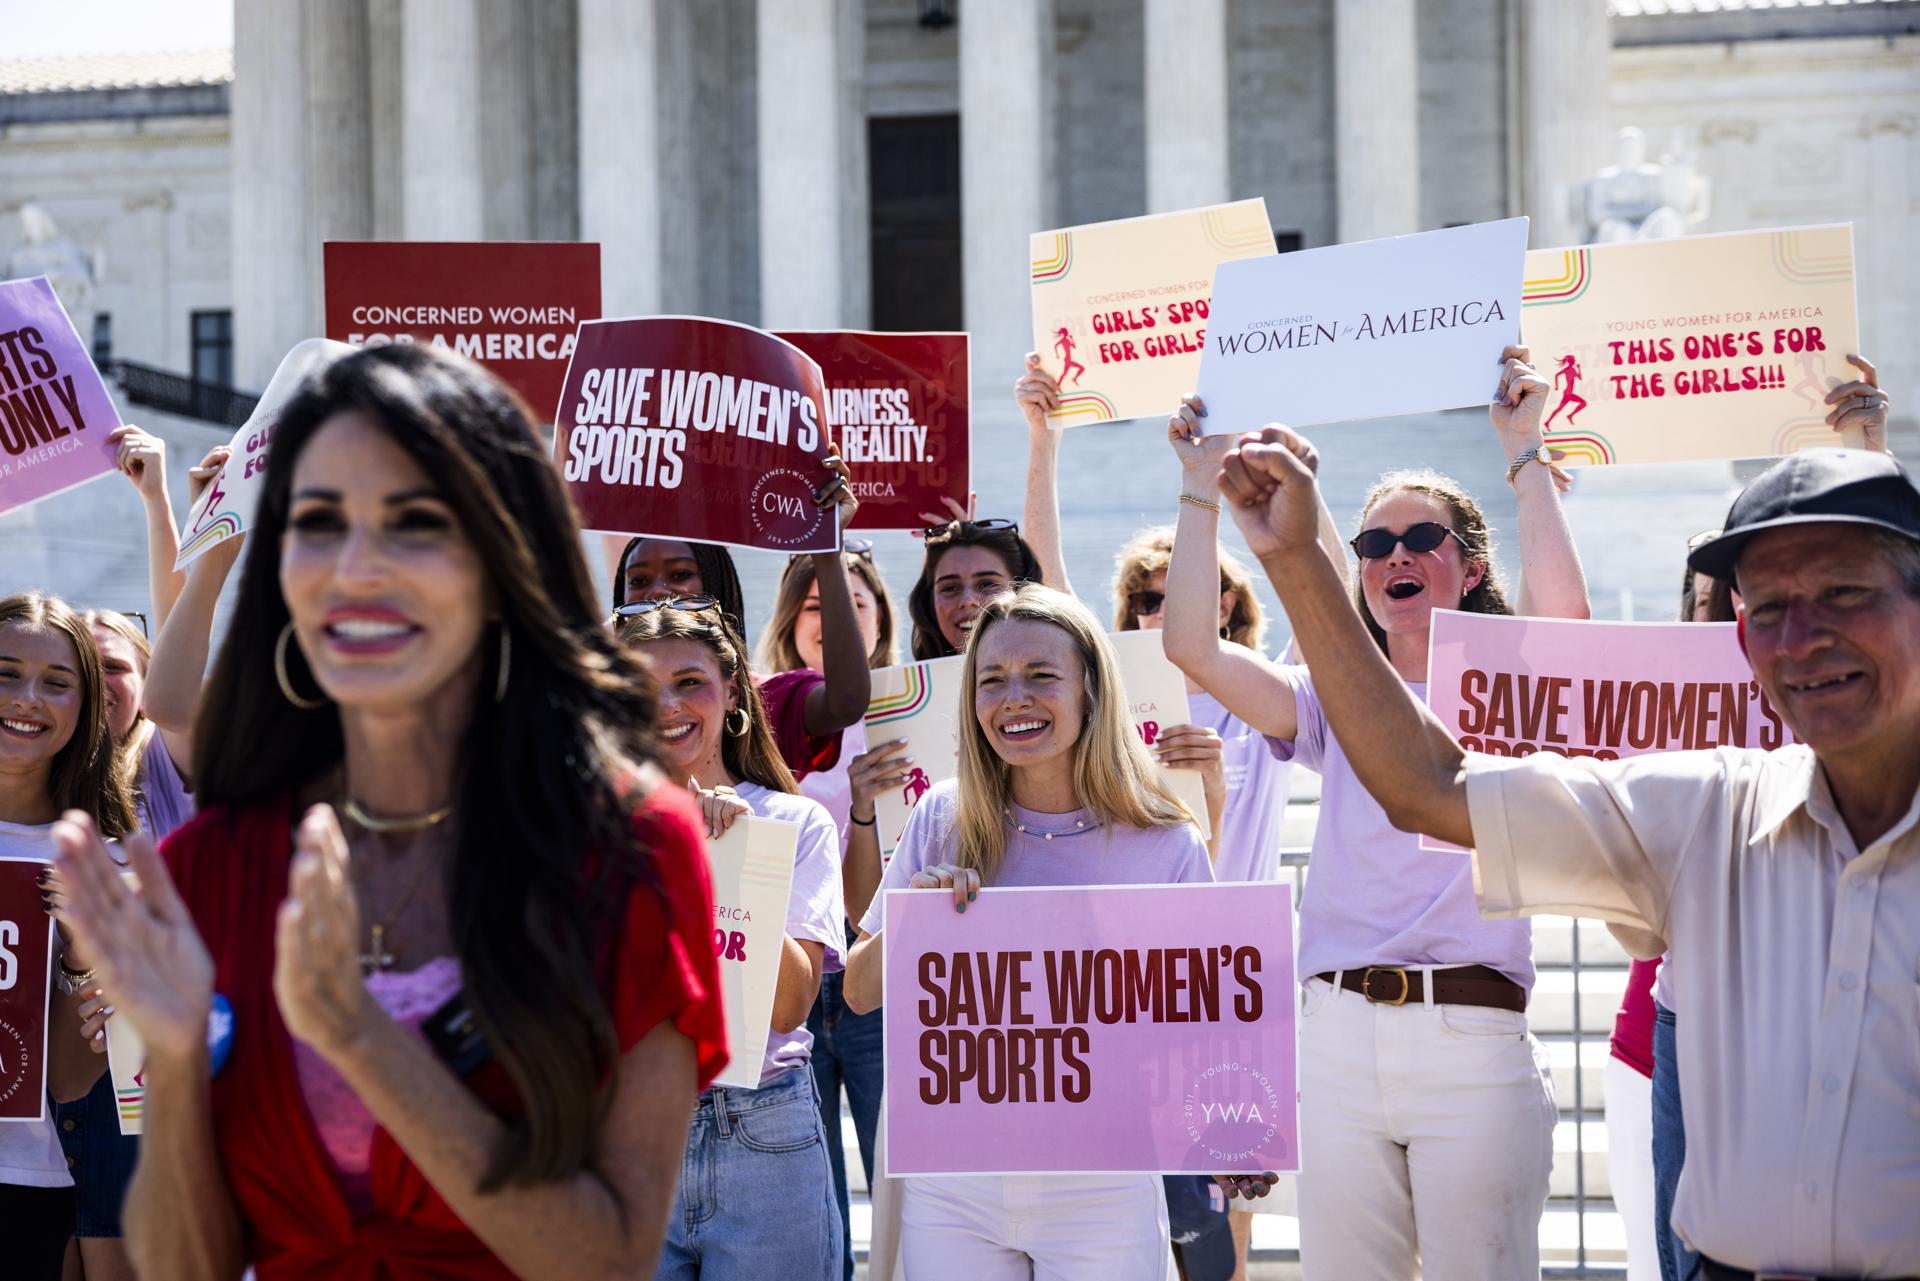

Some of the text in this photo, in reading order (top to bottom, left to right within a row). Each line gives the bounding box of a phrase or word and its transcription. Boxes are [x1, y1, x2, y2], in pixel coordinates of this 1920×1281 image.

[1087, 289, 1146, 304] CONCERNED
[1149, 284, 1185, 297] WOMEN
[352, 306, 575, 325] CONCERNED WOMEN
[1093, 298, 1211, 335] GIRLS' SPO
[1217, 321, 1338, 357] WOMEN
[1354, 299, 1506, 341] AMERICA
[1247, 315, 1312, 330] CONCERNED
[1606, 306, 1823, 332] YOUNG WOMEN FOR AMERICA
[431, 333, 577, 360] AMERICA
[1099, 341, 1139, 364] FOR
[1608, 326, 1826, 366] THIS ONE'S FOR
[1610, 364, 1785, 399] THE GIRLS!!!
[575, 367, 654, 426] SAVE
[659, 368, 819, 453] WOMEN'S
[17, 437, 84, 472] AMERICA
[564, 424, 687, 489] SPORTS
[842, 425, 933, 463] REALITY.
[751, 468, 785, 503] CONCERNED
[790, 522, 820, 544] AMERICA
[763, 492, 807, 520] CWA
[1458, 669, 1783, 750] SAVE WOMEN'S
[918, 944, 1263, 1027] SAVE WOMEN'S
[0, 1019, 28, 1101] MEN FOR AMER
[919, 1026, 1091, 1105] SPORTS
[1202, 1063, 1239, 1079] YOUNG
[1184, 1094, 1194, 1117] 2011
[1252, 1069, 1278, 1109] WOMEN
[1201, 1102, 1263, 1123] YWA
[1262, 1123, 1277, 1144] FOR
[1209, 1148, 1254, 1161] AMERICA
